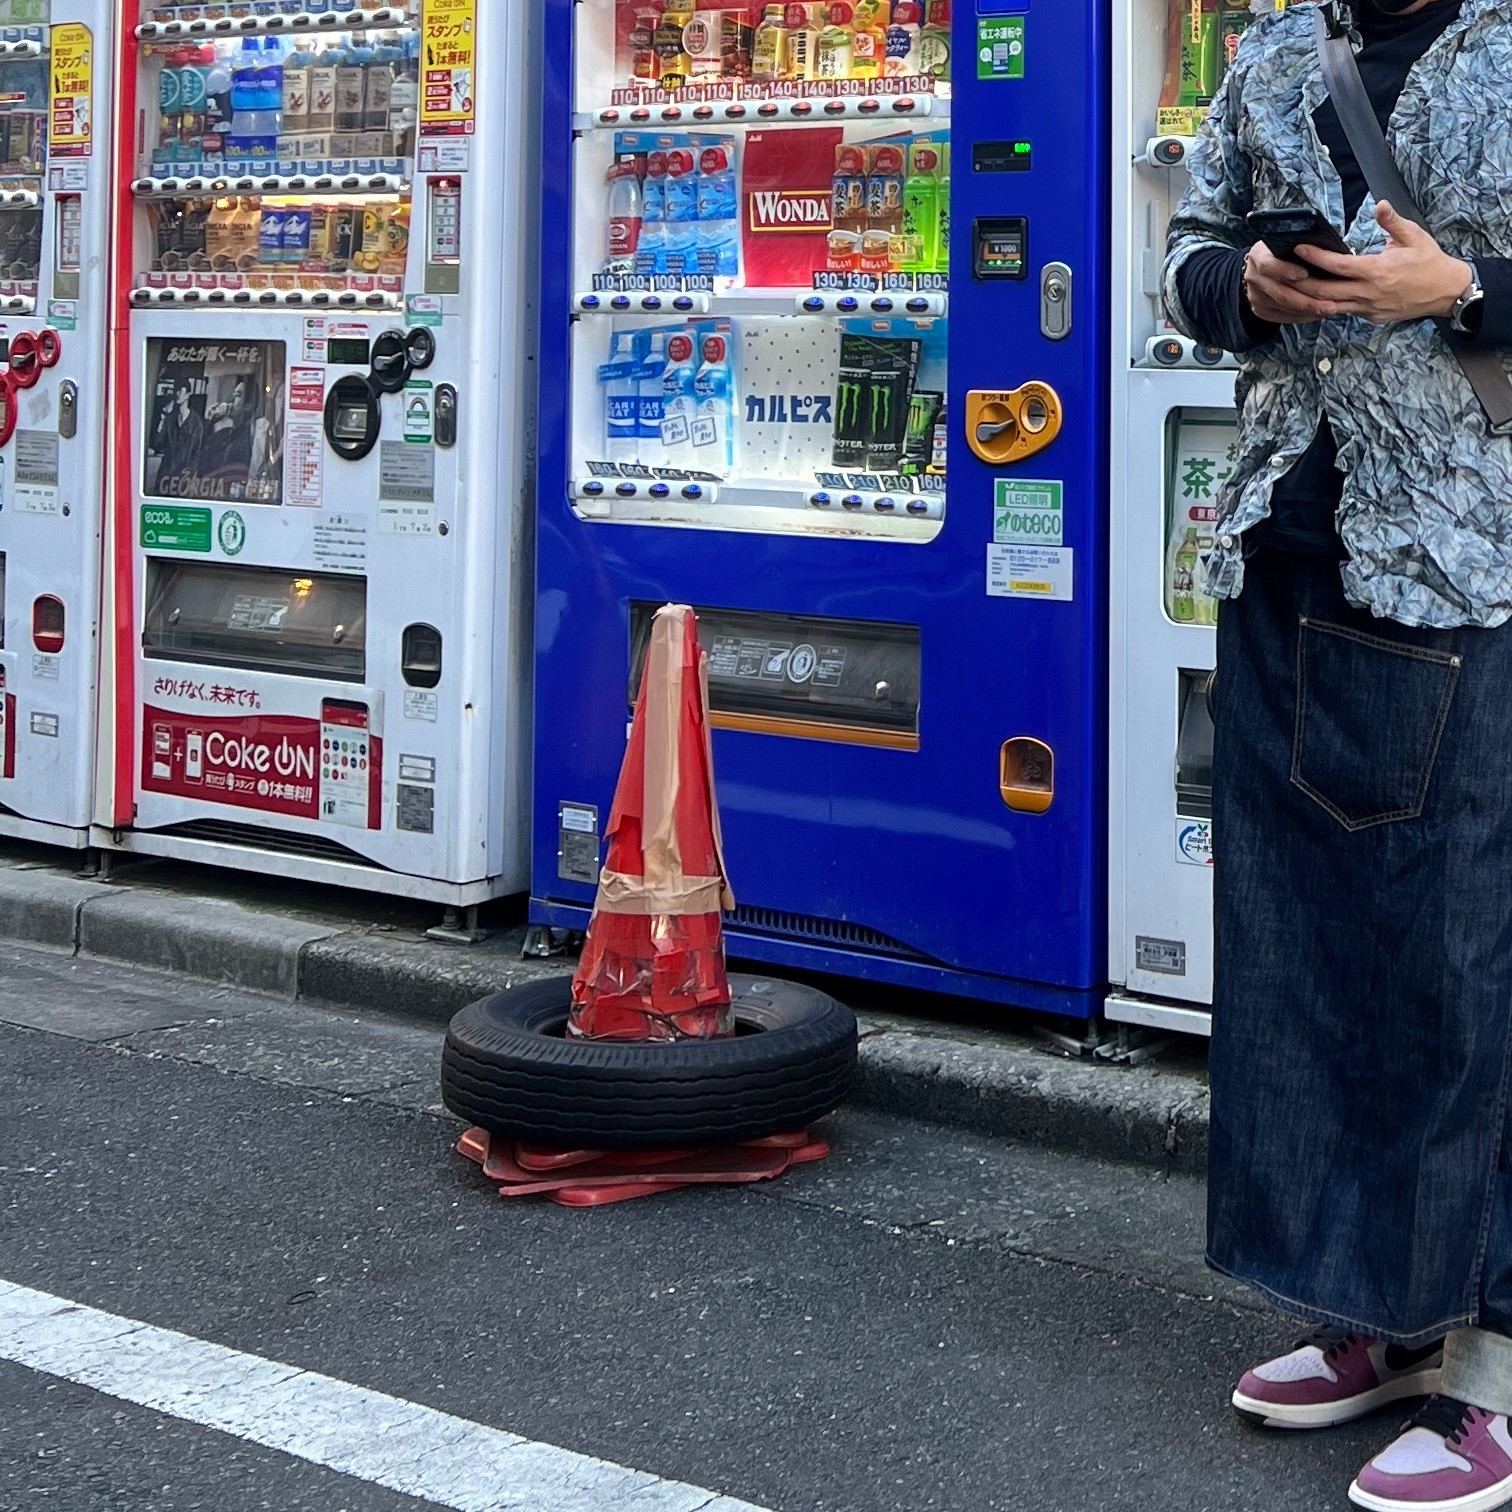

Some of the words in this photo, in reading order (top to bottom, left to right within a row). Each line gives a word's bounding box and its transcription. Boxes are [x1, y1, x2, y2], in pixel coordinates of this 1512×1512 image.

[426, 23, 463, 38] スタンプ
[54, 56, 82, 69] スタンプ
[754, 190, 829, 225] WONDA
[745, 394, 832, 423] カルピス
[1008, 493, 1048, 506] LED照明
[153, 676, 262, 710] さりげなく、未来です。
[205, 731, 271, 773] Coke
[274, 735, 314, 780] ON
